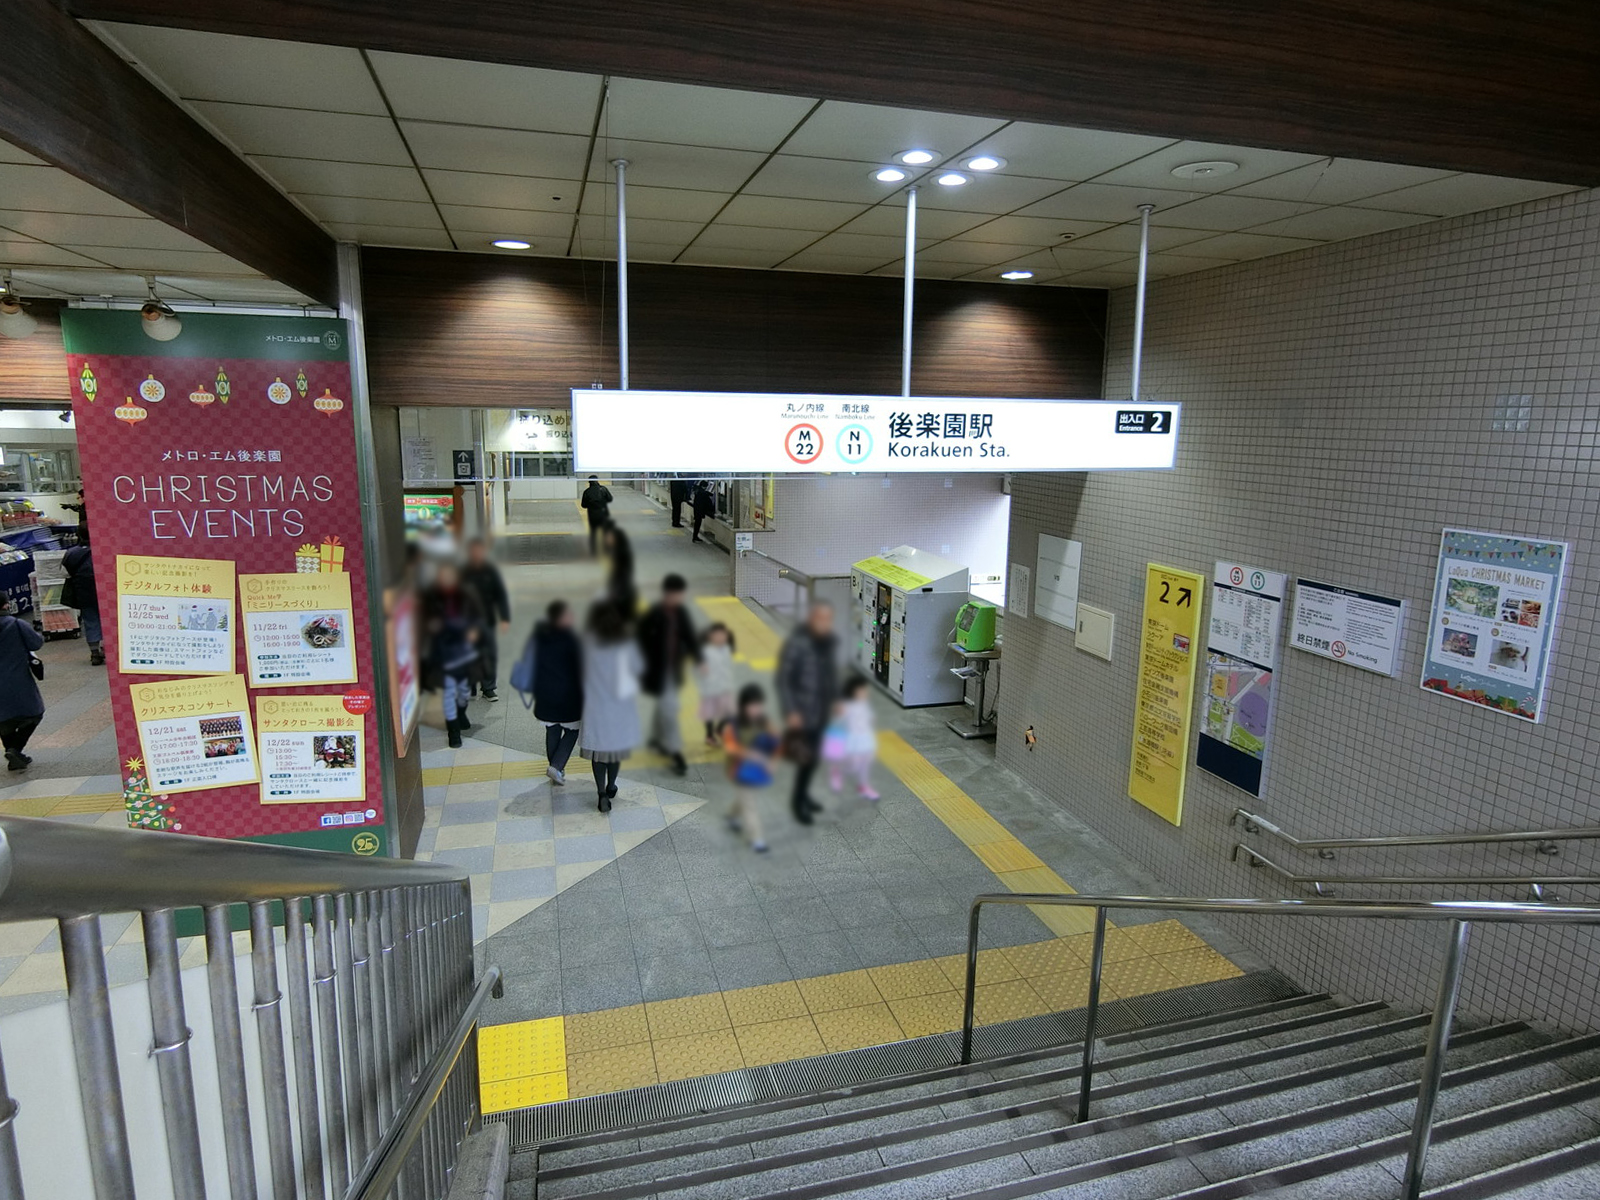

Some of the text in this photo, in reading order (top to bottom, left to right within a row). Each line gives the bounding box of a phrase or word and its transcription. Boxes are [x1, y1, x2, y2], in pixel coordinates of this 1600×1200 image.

[786, 403, 824, 412] 丸ノ内線
[842, 404, 870, 413] 南北線
[888, 412, 993, 439] 後楽園駅
[1120, 414, 1144, 424] 出入口
[1150, 412, 1163, 432] 2
[799, 430, 811, 441] M
[850, 430, 860, 441] N
[162, 450, 282, 462] メトロ・エム後楽園
[796, 444, 814, 455] 22
[847, 444, 862, 455] 11
[888, 442, 1010, 458] Korakuen Sta.
[114, 475, 334, 503] CHRISTMAS
[152, 509, 304, 538] EVENTS
[1472, 567, 1512, 584] CHRISTMAS
[1514, 574, 1546, 590] MARKET
[124, 580, 212, 594] デジタルフォト体験
[1160, 581, 1169, 604] 2
[1297, 632, 1330, 652] 終日禁煙
[142, 699, 232, 716] クリスマスコンサート
[264, 718, 354, 727] サンタクロース撮影会
[148, 726, 174, 735] 12/21
